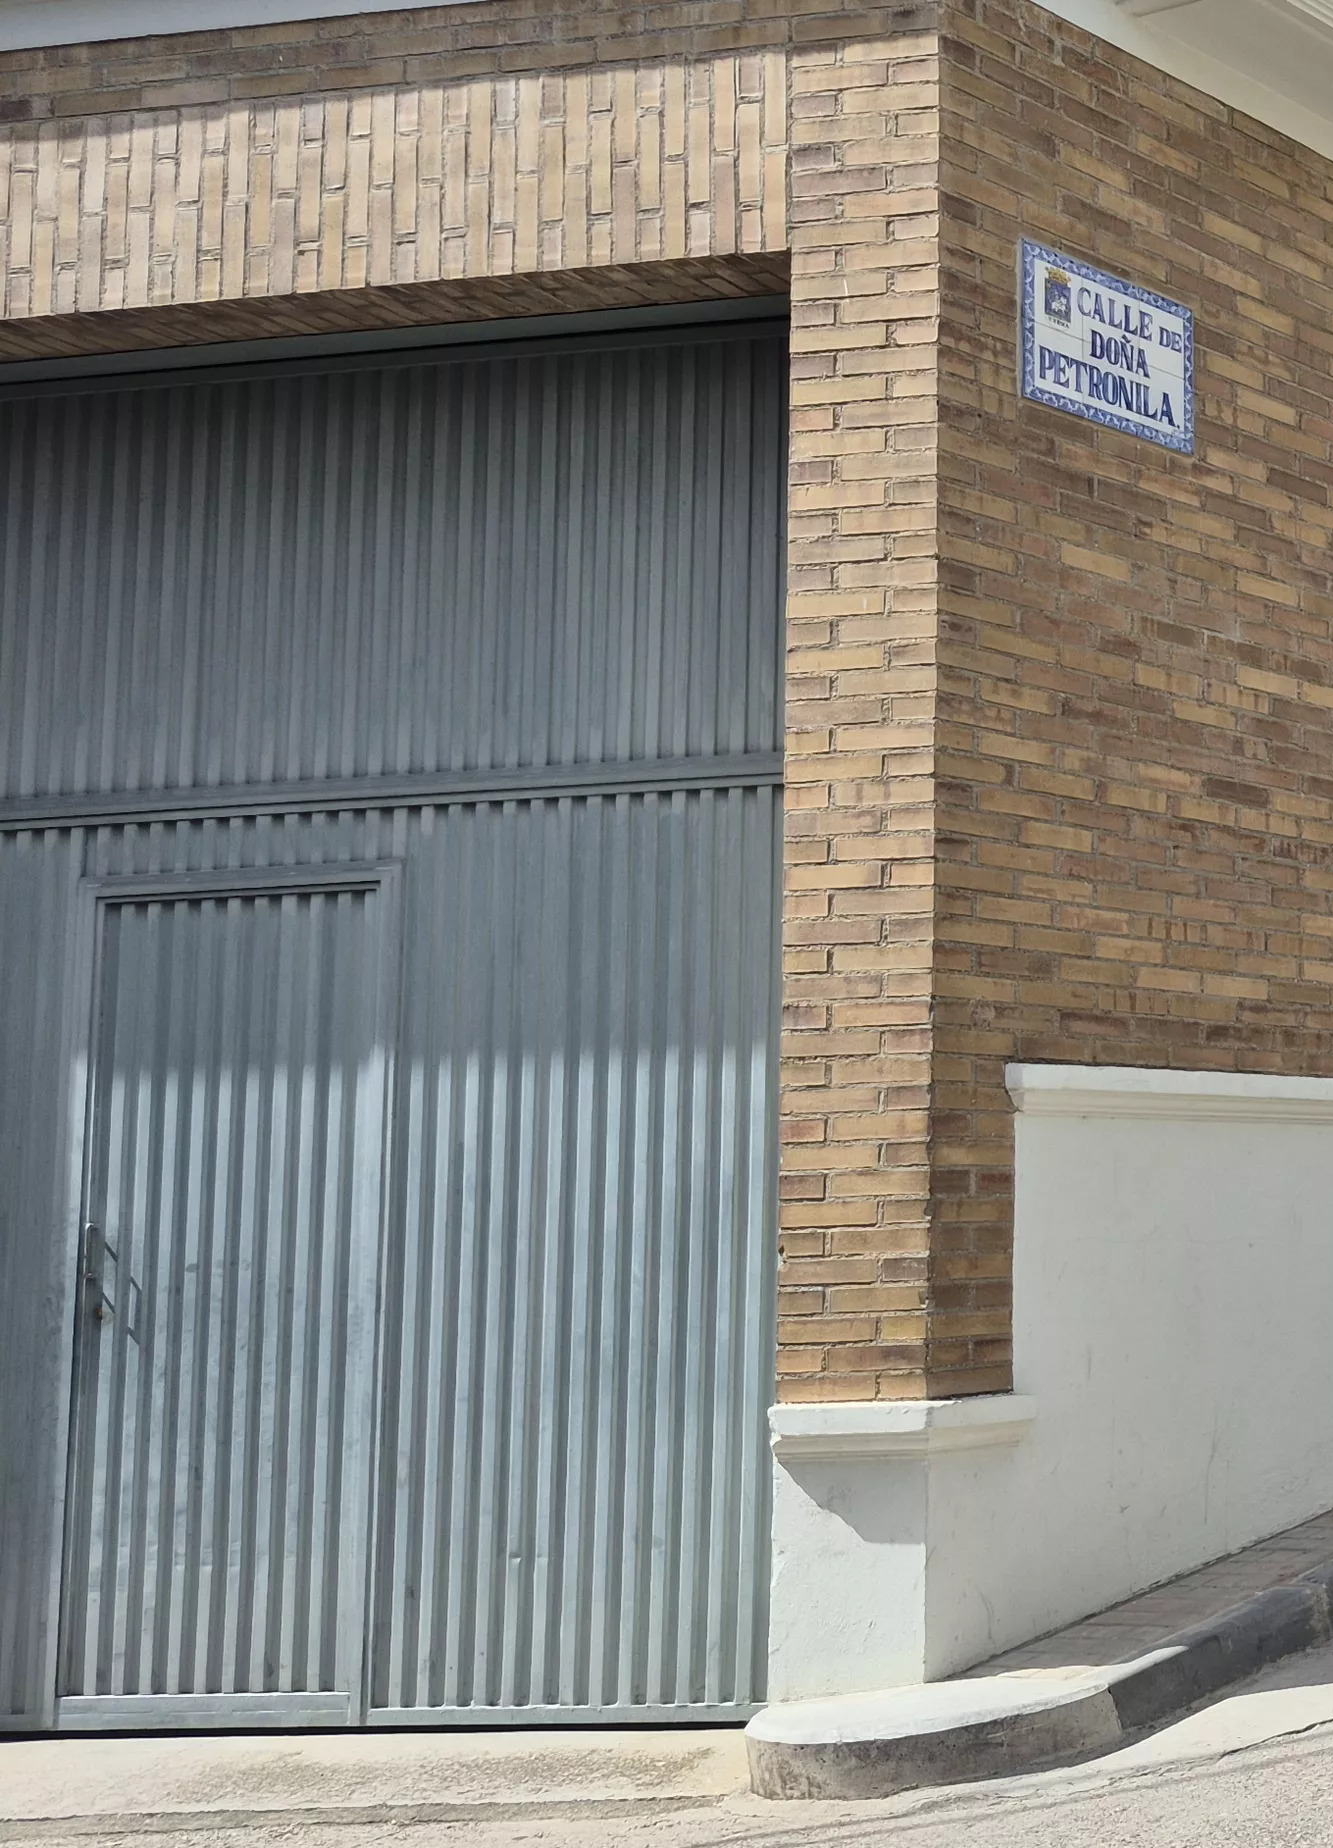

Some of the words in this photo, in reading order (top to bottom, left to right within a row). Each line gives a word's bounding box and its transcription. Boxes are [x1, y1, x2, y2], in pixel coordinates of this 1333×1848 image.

[1077, 287, 1152, 341] CALLE
[1159, 327, 1182, 353] DE
[1089, 329, 1151, 378] DOÑA
